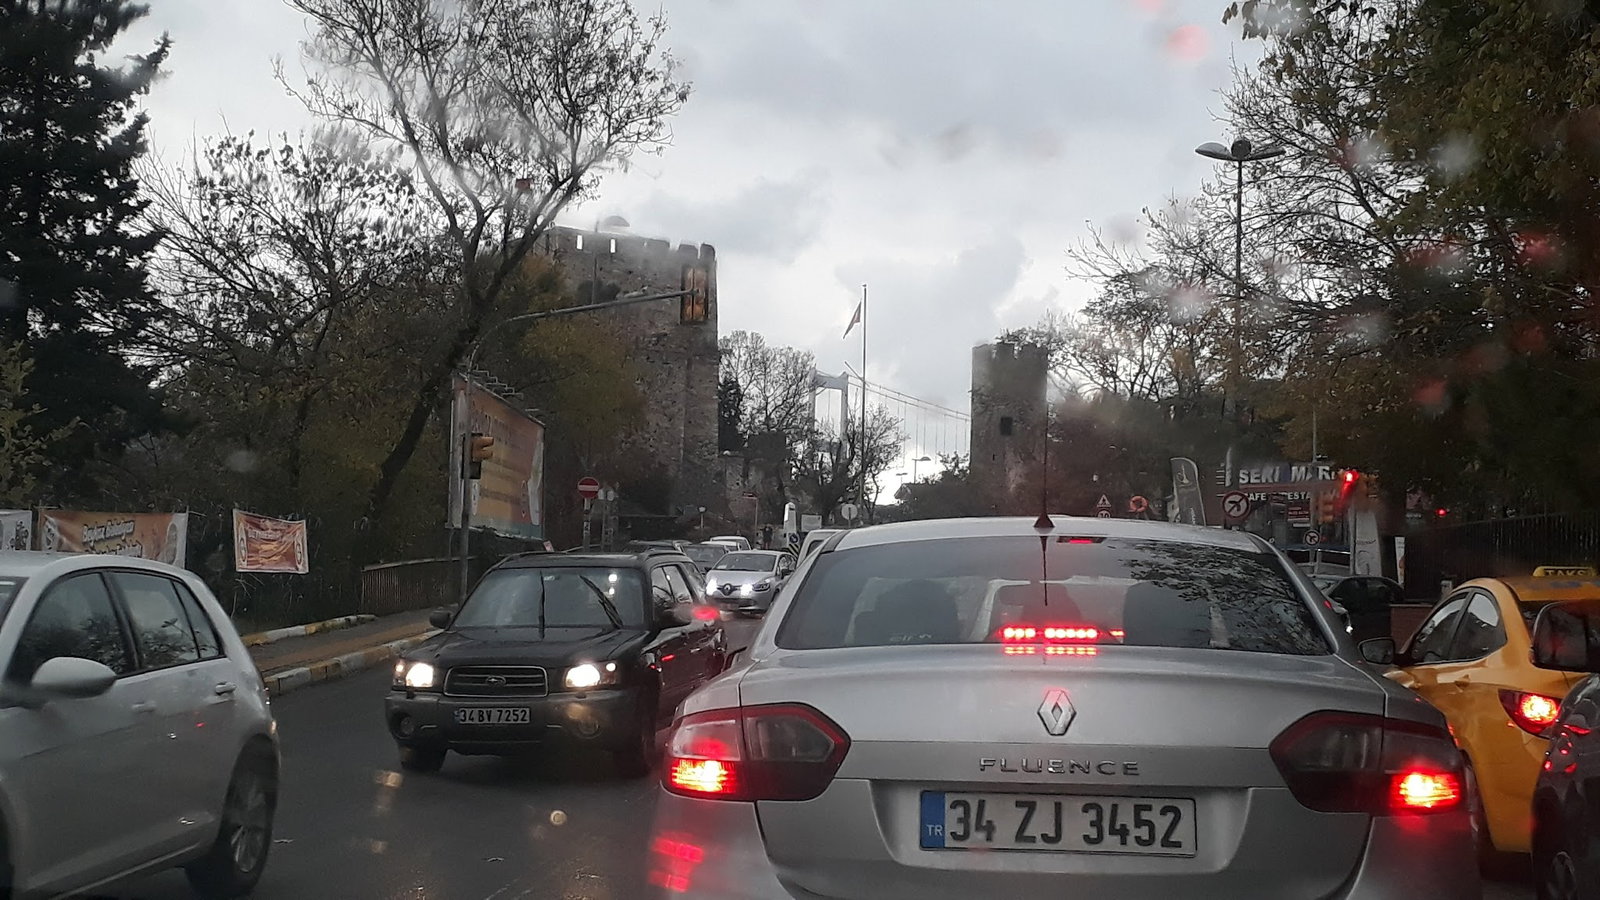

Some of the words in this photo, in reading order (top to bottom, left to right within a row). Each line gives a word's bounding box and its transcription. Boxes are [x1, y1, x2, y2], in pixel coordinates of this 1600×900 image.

[1244, 491, 1267, 501] AFE
[460, 709, 474, 722] 34
[478, 709, 492, 722] BV
[497, 709, 527, 722] 7252
[979, 757, 1140, 776] FLUENCE
[927, 824, 942, 836] TR
[949, 800, 996, 842] 34
[1014, 800, 1063, 844] ZJ
[1081, 802, 1182, 848] 3452
